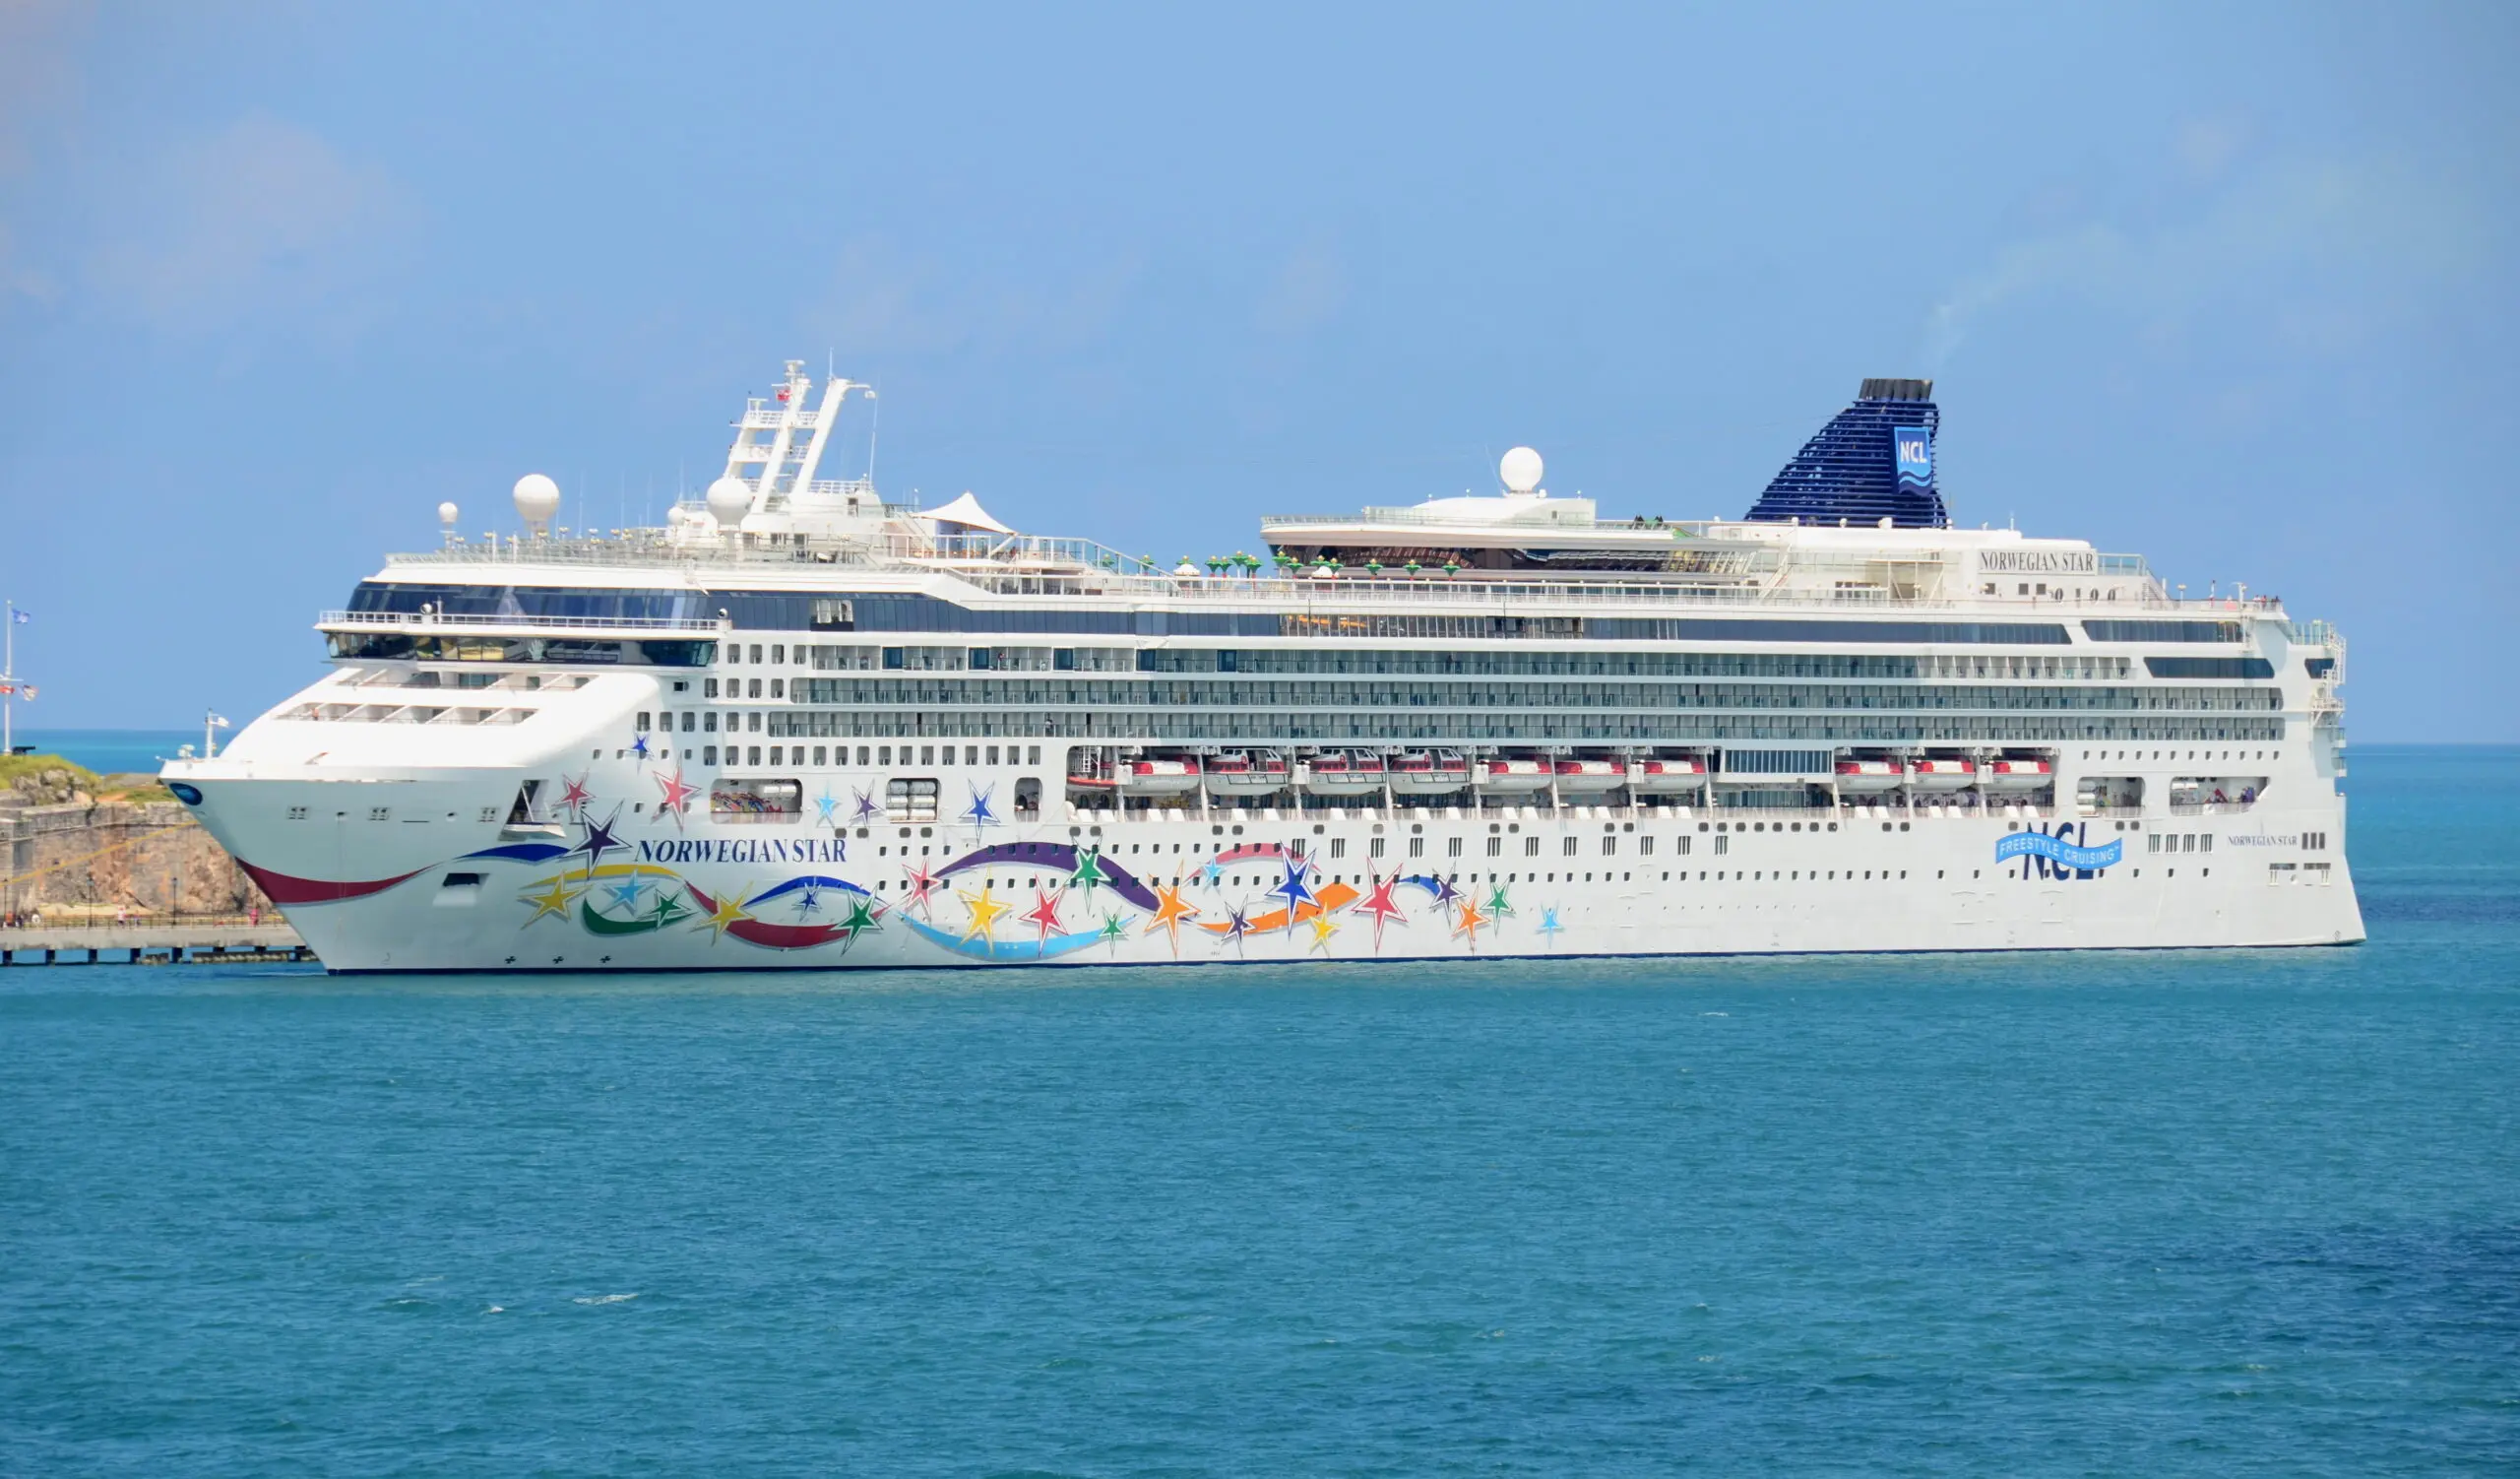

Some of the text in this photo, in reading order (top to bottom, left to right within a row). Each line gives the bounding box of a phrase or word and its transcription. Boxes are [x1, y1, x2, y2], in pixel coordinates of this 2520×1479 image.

[1899, 440, 1927, 464] NCL
[1981, 550, 2094, 571] NORWEGIAN STAR
[634, 838, 847, 863] NORWEGIAN STAR
[1999, 837, 2059, 857] FREESTYLE
[2023, 821, 2094, 880] NCL
[2228, 835, 2298, 846] NORWEGIAN STAR
